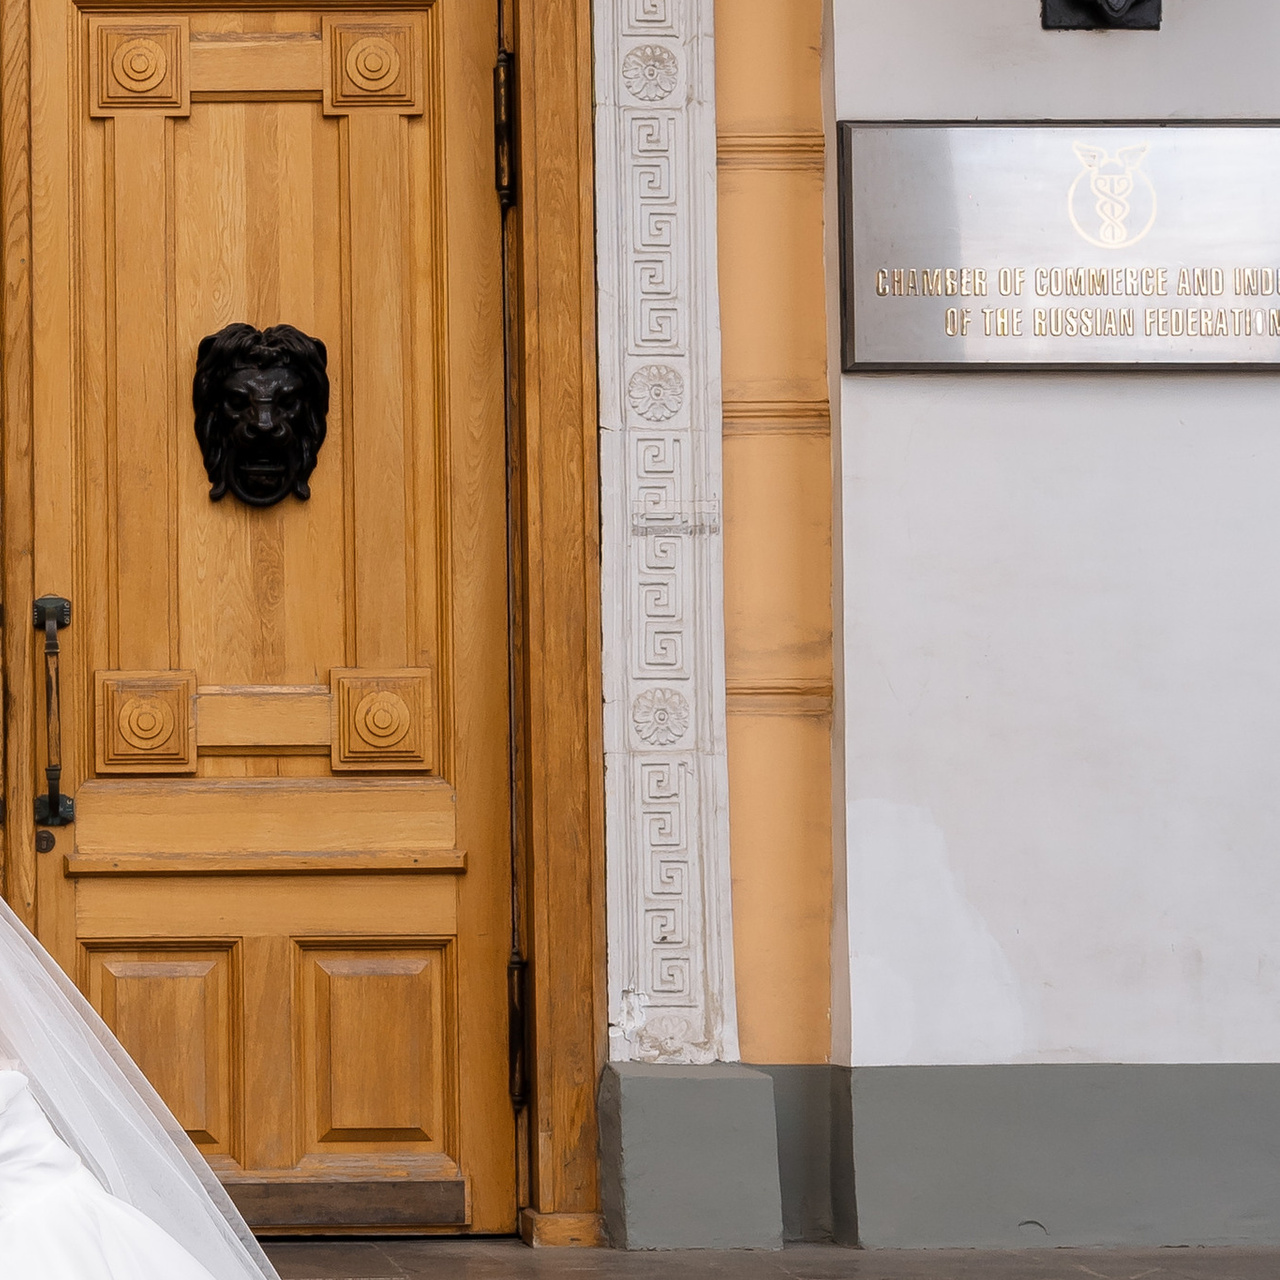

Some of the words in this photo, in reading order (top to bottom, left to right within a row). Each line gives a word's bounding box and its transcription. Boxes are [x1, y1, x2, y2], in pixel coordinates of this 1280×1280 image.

[875, 267, 989, 297] CHAMBER
[998, 267, 1026, 297] OF
[1034, 267, 1168, 297] COMMERCE
[1177, 267, 1225, 297] AND
[1234, 267, 1280, 296] IND
[944, 307, 970, 337] OF
[982, 307, 1023, 337] THE
[1033, 307, 1135, 337] RUSSIAN
[1144, 307, 1280, 337] FEDERATION
